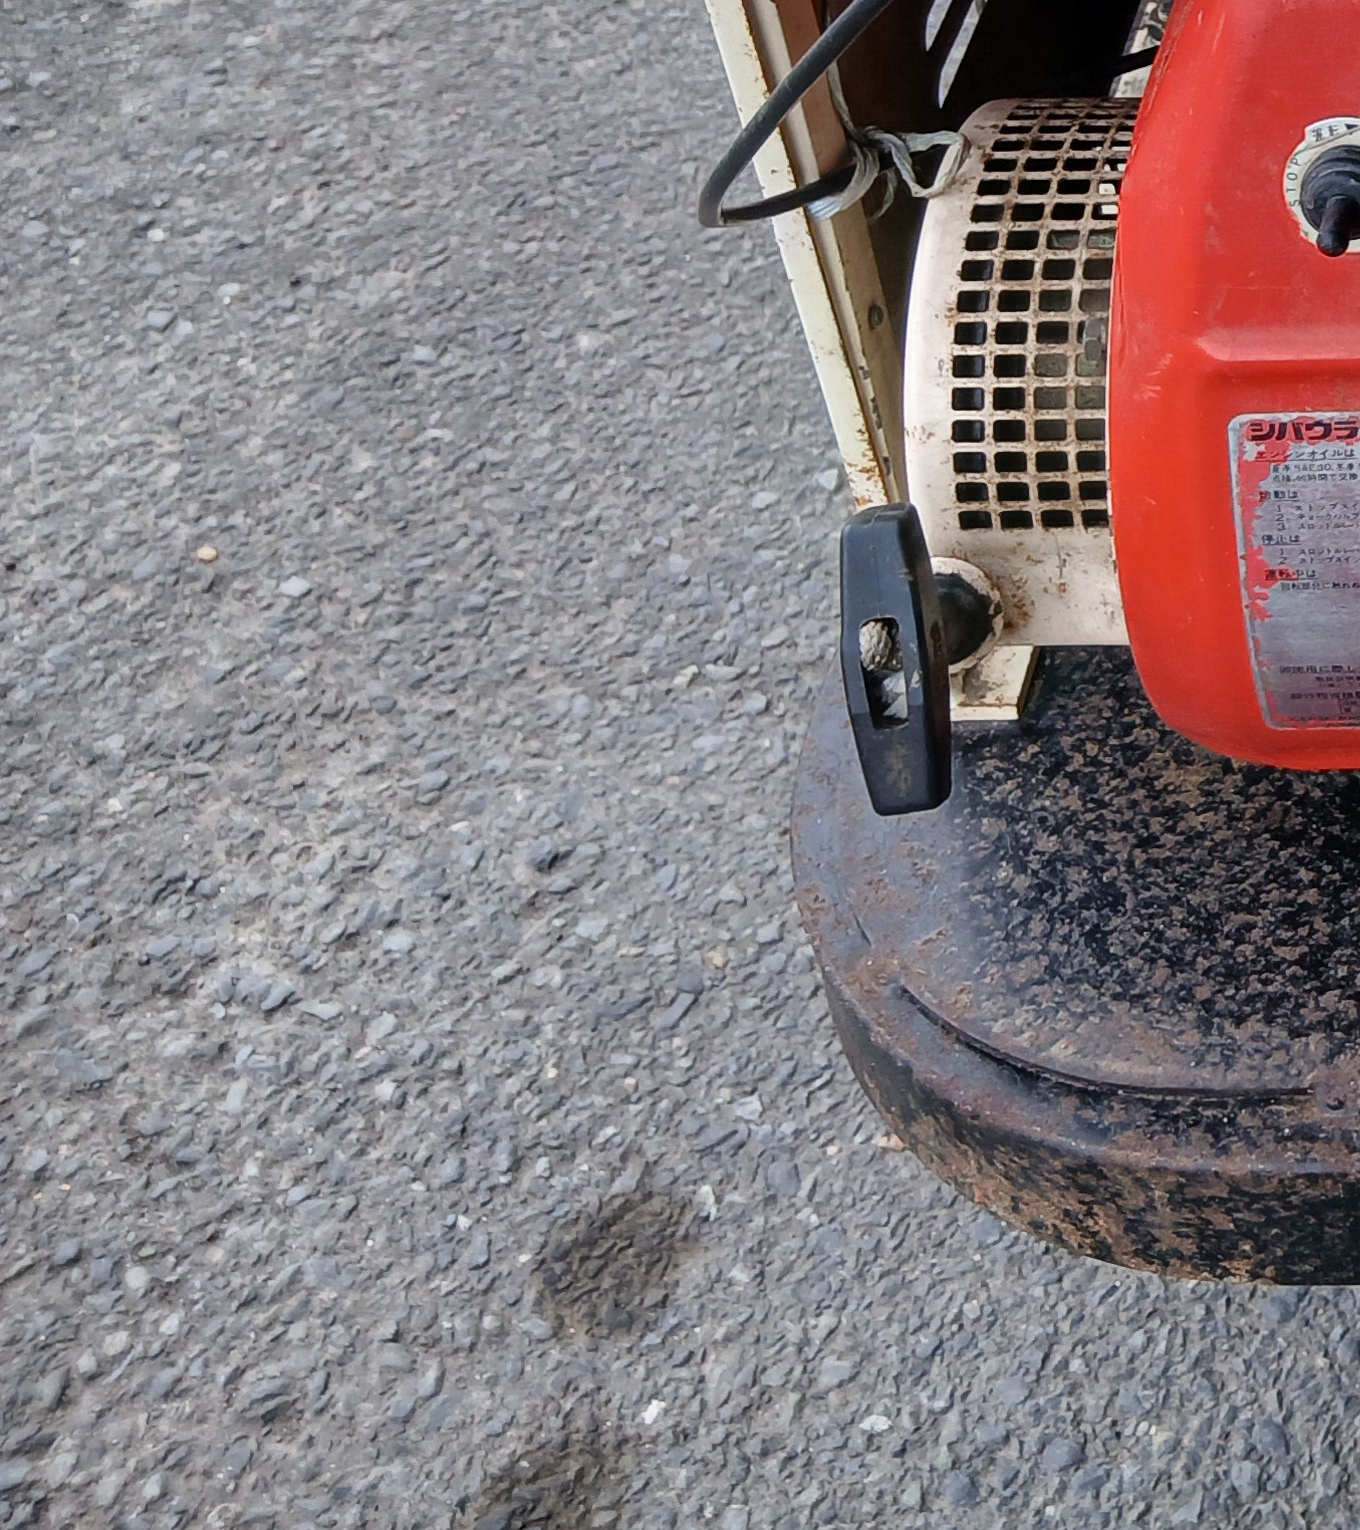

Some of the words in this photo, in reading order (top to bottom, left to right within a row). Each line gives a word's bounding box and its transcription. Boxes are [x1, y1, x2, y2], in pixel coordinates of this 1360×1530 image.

[1286, 156, 1303, 208] STOP
[1249, 421, 1360, 443] シバウラ
[1261, 534, 1301, 545] 停止は
